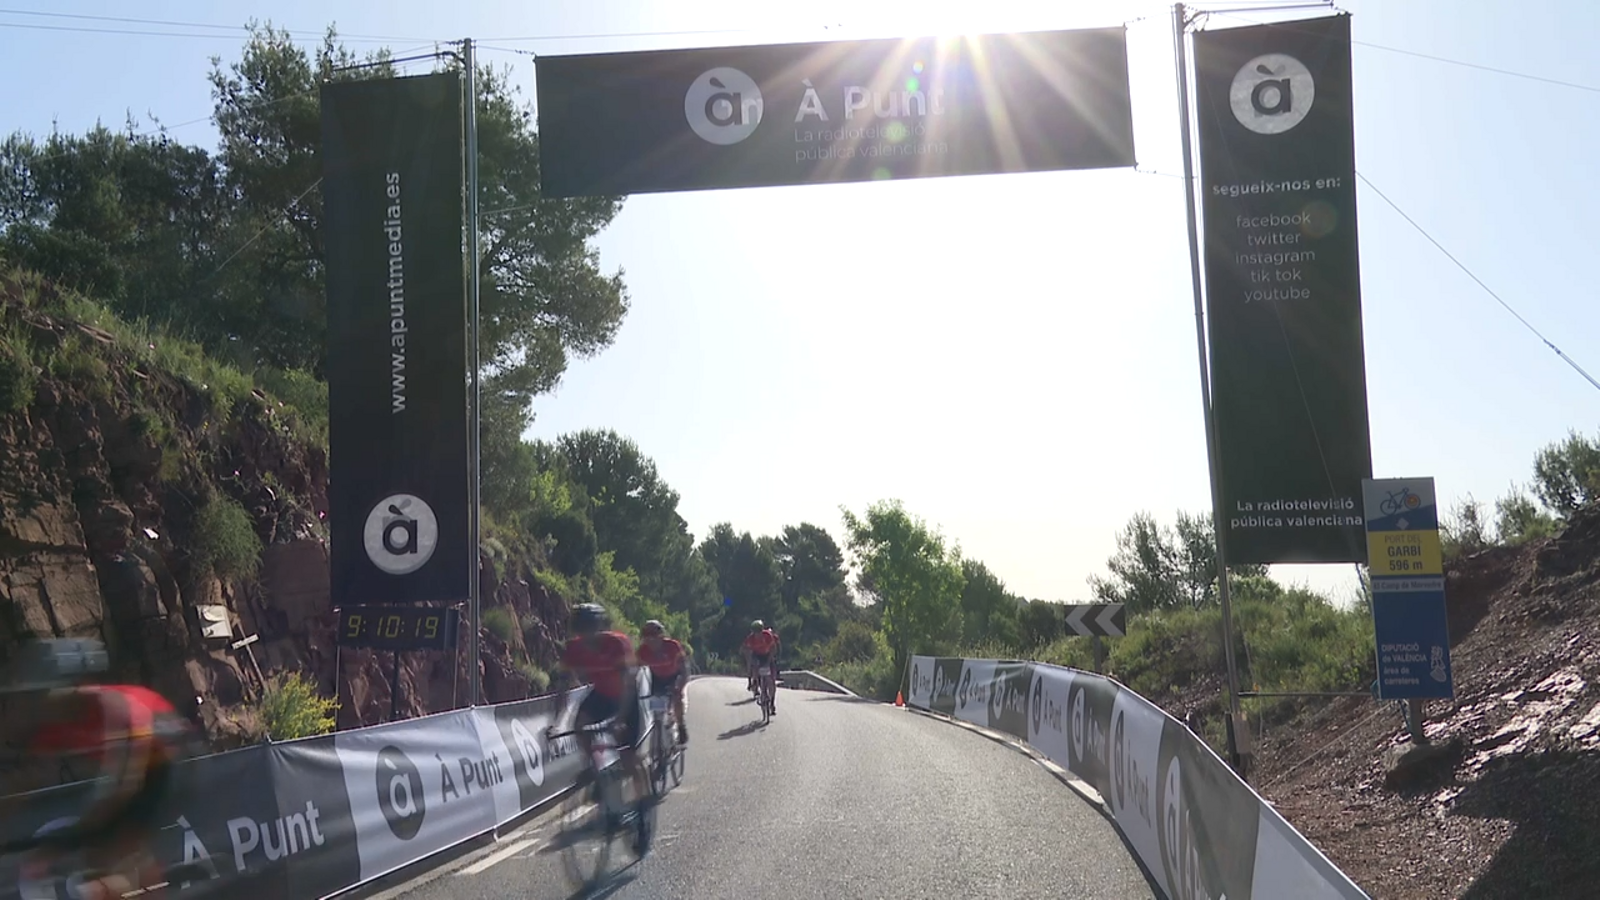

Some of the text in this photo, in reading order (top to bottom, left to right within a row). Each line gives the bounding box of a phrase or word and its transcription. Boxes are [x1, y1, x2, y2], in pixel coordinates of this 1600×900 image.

[794, 78, 945, 122] À Punt
[794, 121, 926, 142] La radiotelevisió
[795, 141, 949, 164] pública valenciana
[1212, 177, 1341, 197] segueix-nos en:
[1236, 211, 1311, 228] facebook
[1247, 232, 1301, 246] twitter
[1235, 250, 1316, 268] instagram
[1251, 268, 1301, 282] tik tok
[384, 172, 408, 414] www.apuntmedia.es
[1244, 286, 1311, 303] youtube
[1236, 496, 1354, 512] La radiotelevisió
[1231, 513, 1363, 529] pública valenciana
[1389, 560, 1423, 571] 596 m
[347, 615, 439, 639] 9:10:19
[435, 753, 460, 803] À
[458, 751, 503, 795] Punt
[227, 800, 326, 871] Punt
